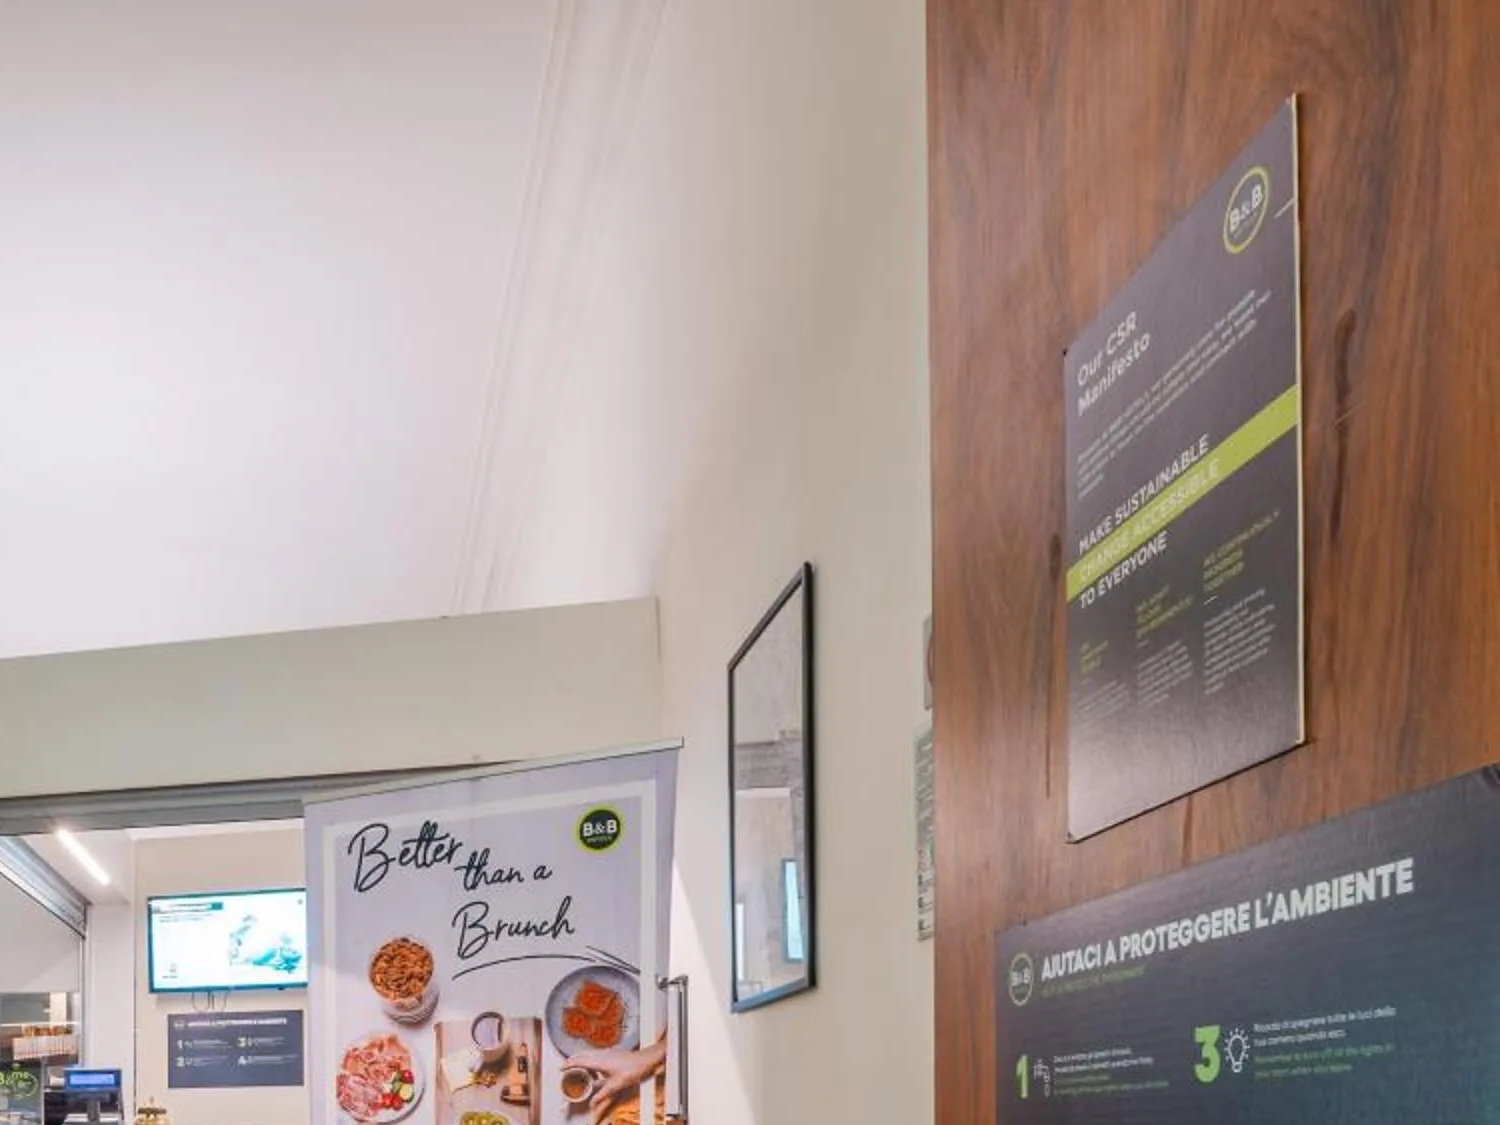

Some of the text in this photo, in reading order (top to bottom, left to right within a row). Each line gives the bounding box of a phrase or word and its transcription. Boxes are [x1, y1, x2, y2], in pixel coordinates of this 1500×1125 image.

[1077, 311, 1137, 386] Our CSR
[1078, 333, 1150, 417] Manifesto
[1078, 515, 1112, 555] MAKE
[1115, 433, 1209, 524] SUSTAINABLE
[1080, 587, 1095, 608] TO
[1098, 530, 1169, 596] EVERYONE
[348, 820, 464, 892] Better
[583, 819, 617, 837] B&B
[455, 848, 552, 890] than a
[452, 896, 576, 960] Brunch
[1041, 942, 1101, 981] AIUTACI
[1104, 939, 1117, 966] A
[1119, 901, 1250, 962] PROTEGGERE
[1255, 857, 1414, 929] L'AMBIENTE
[1016, 1055, 1028, 1099] 1
[1194, 1025, 1221, 1083] 3
